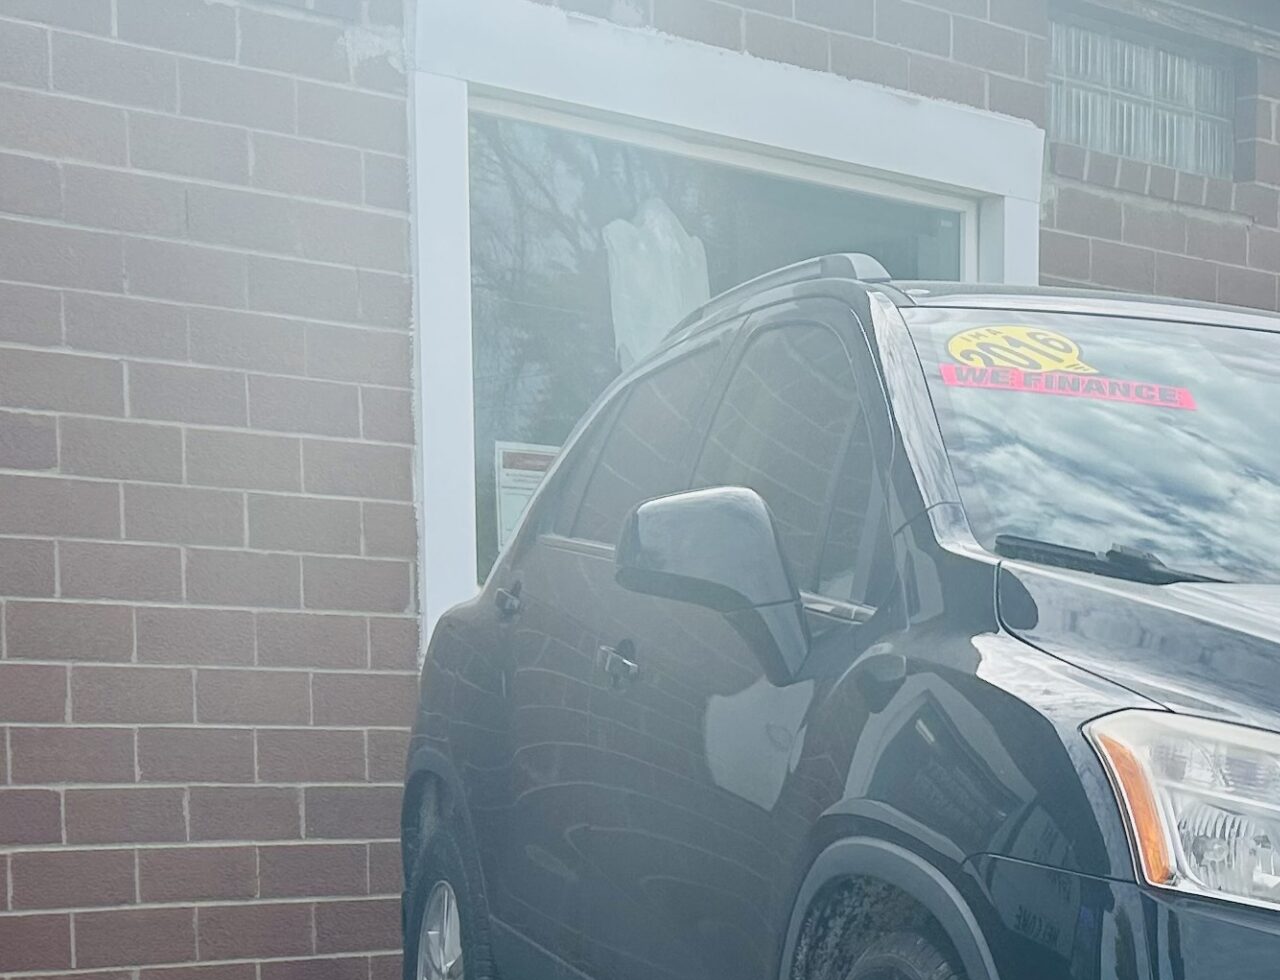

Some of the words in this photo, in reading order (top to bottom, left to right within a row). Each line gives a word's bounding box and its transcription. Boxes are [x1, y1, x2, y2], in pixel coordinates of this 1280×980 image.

[959, 330, 1073, 370] 2016
[954, 366, 1011, 386] WE
[1023, 372, 1178, 402] FINANCE
